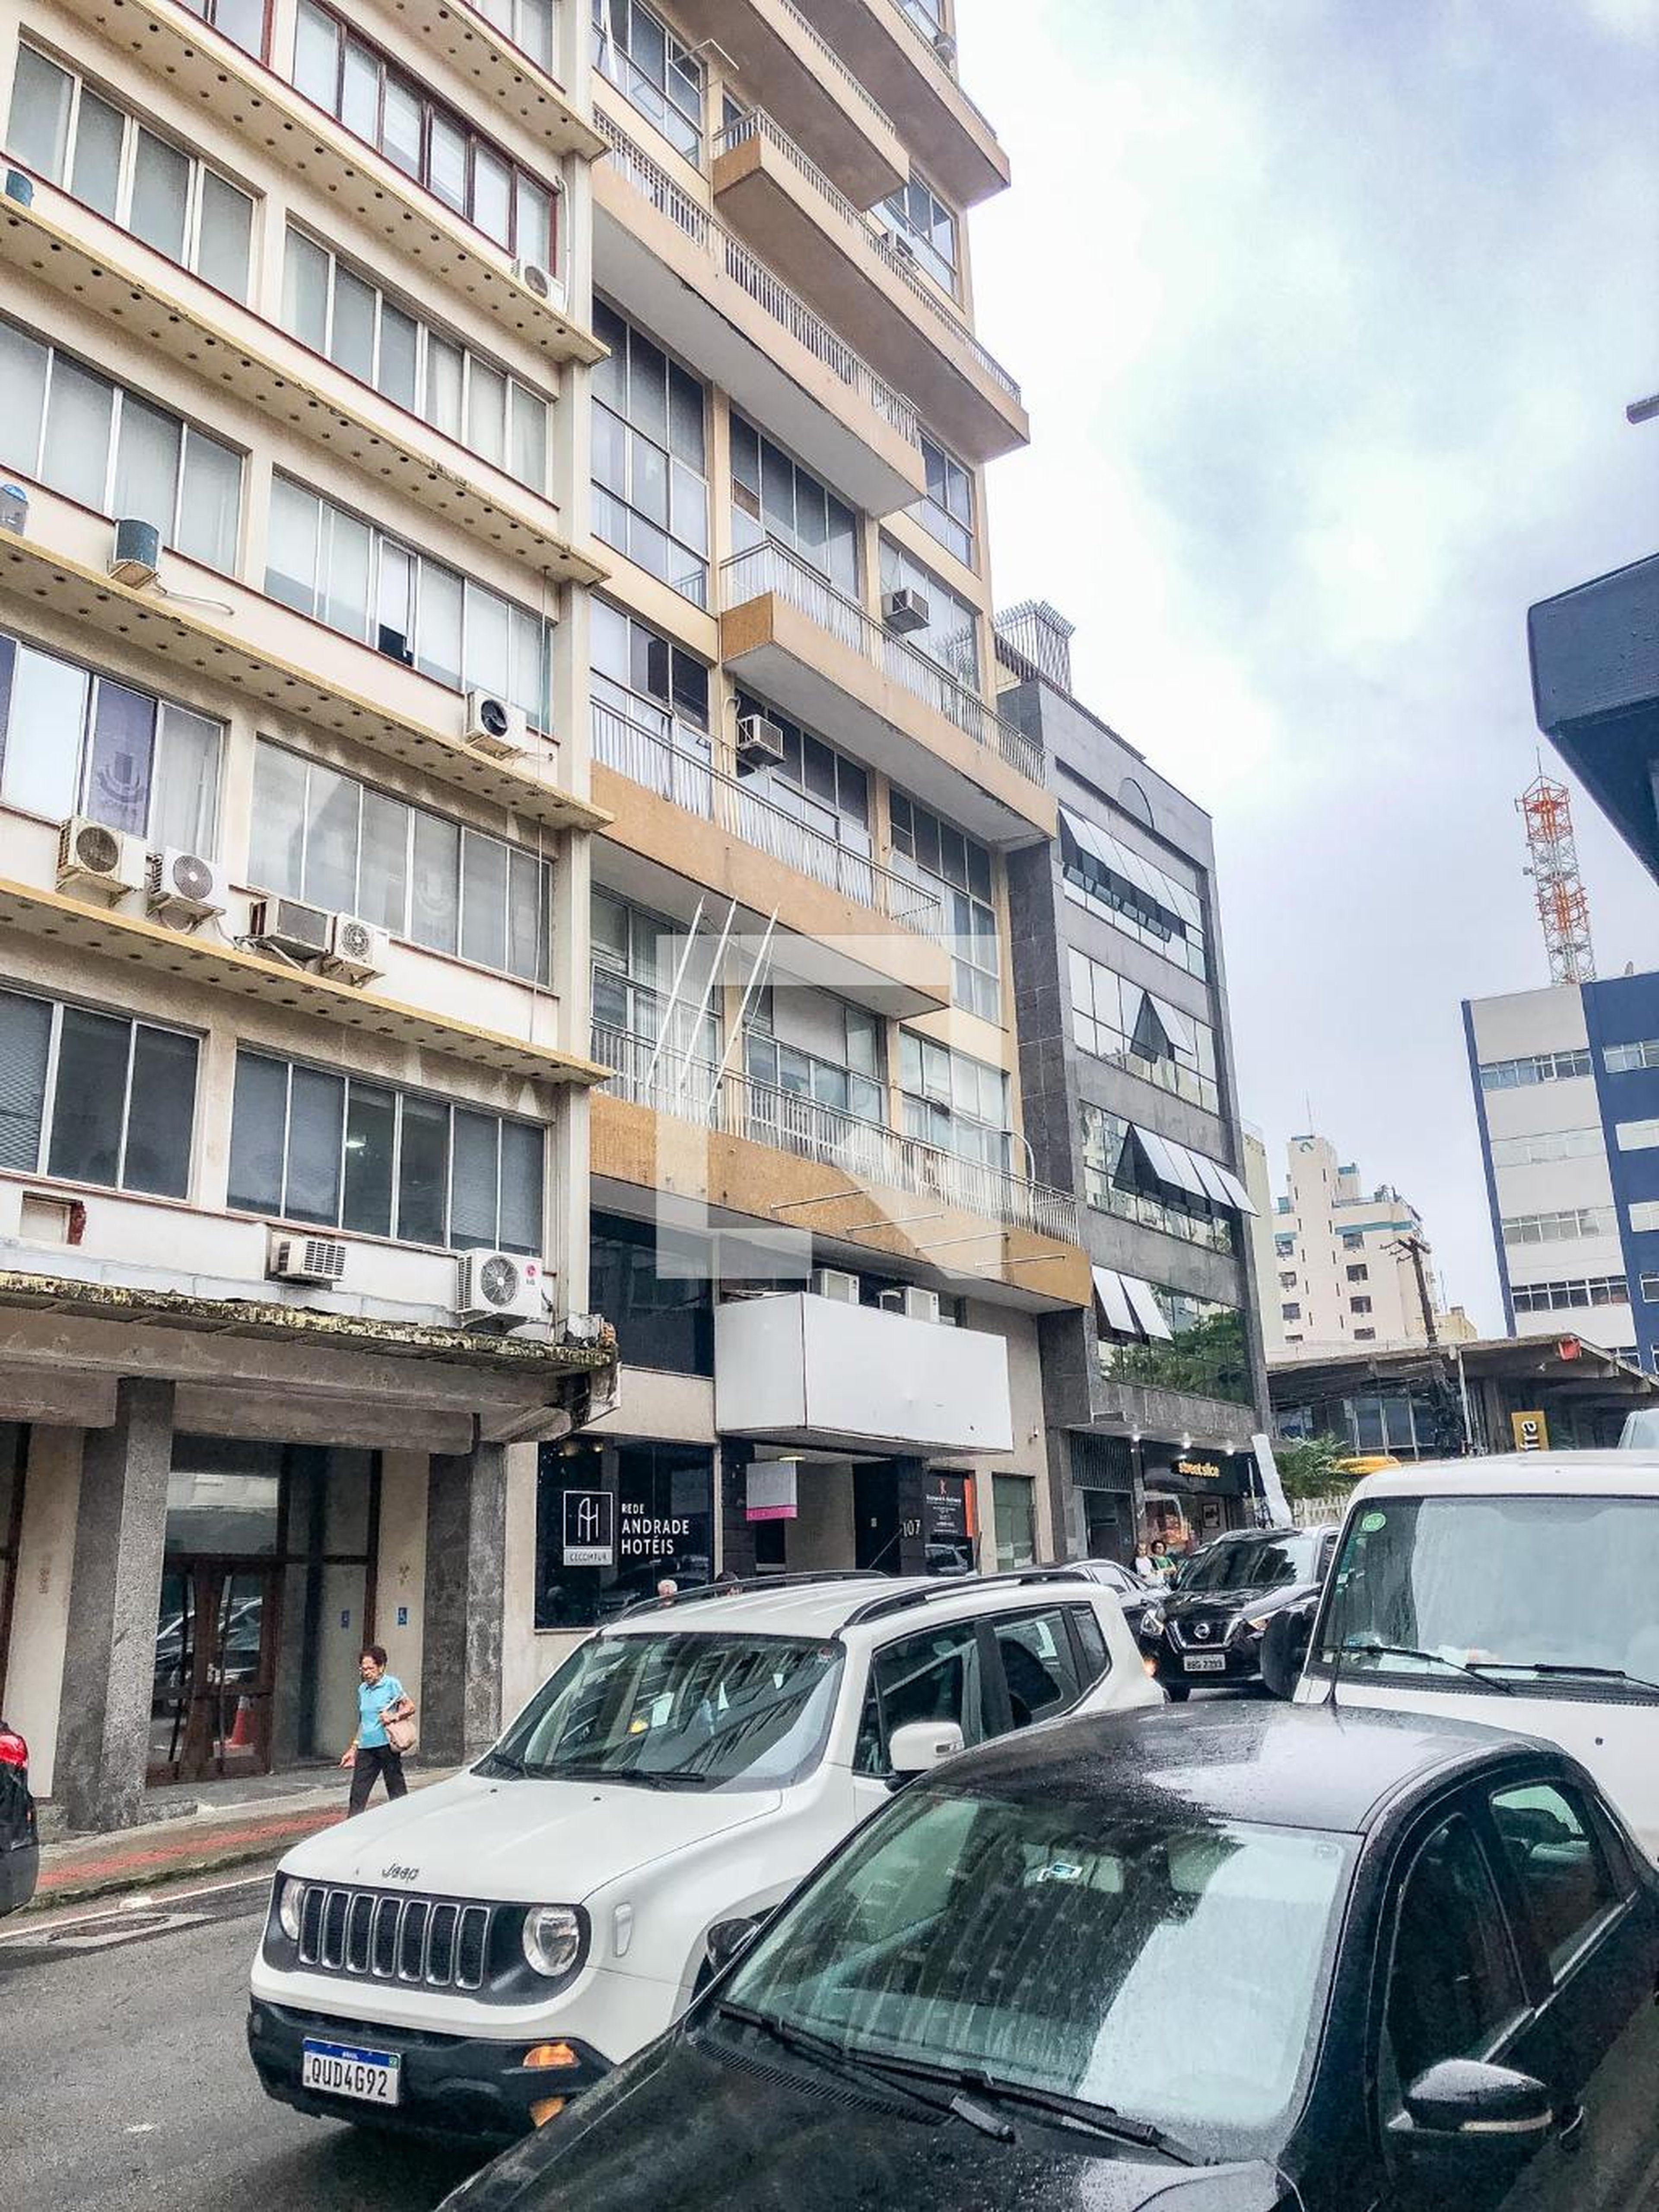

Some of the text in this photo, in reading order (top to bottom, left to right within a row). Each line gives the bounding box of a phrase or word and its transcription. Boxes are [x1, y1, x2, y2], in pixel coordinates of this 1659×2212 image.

[621, 1503, 645, 1514] REDE
[621, 1518, 690, 1534] ANDRADE
[903, 1519, 921, 1537] 107
[621, 1535, 674, 1554] HOTÉIS
[382, 1863, 419, 1883] Jeep
[312, 2057, 387, 2097] QUD4G92
